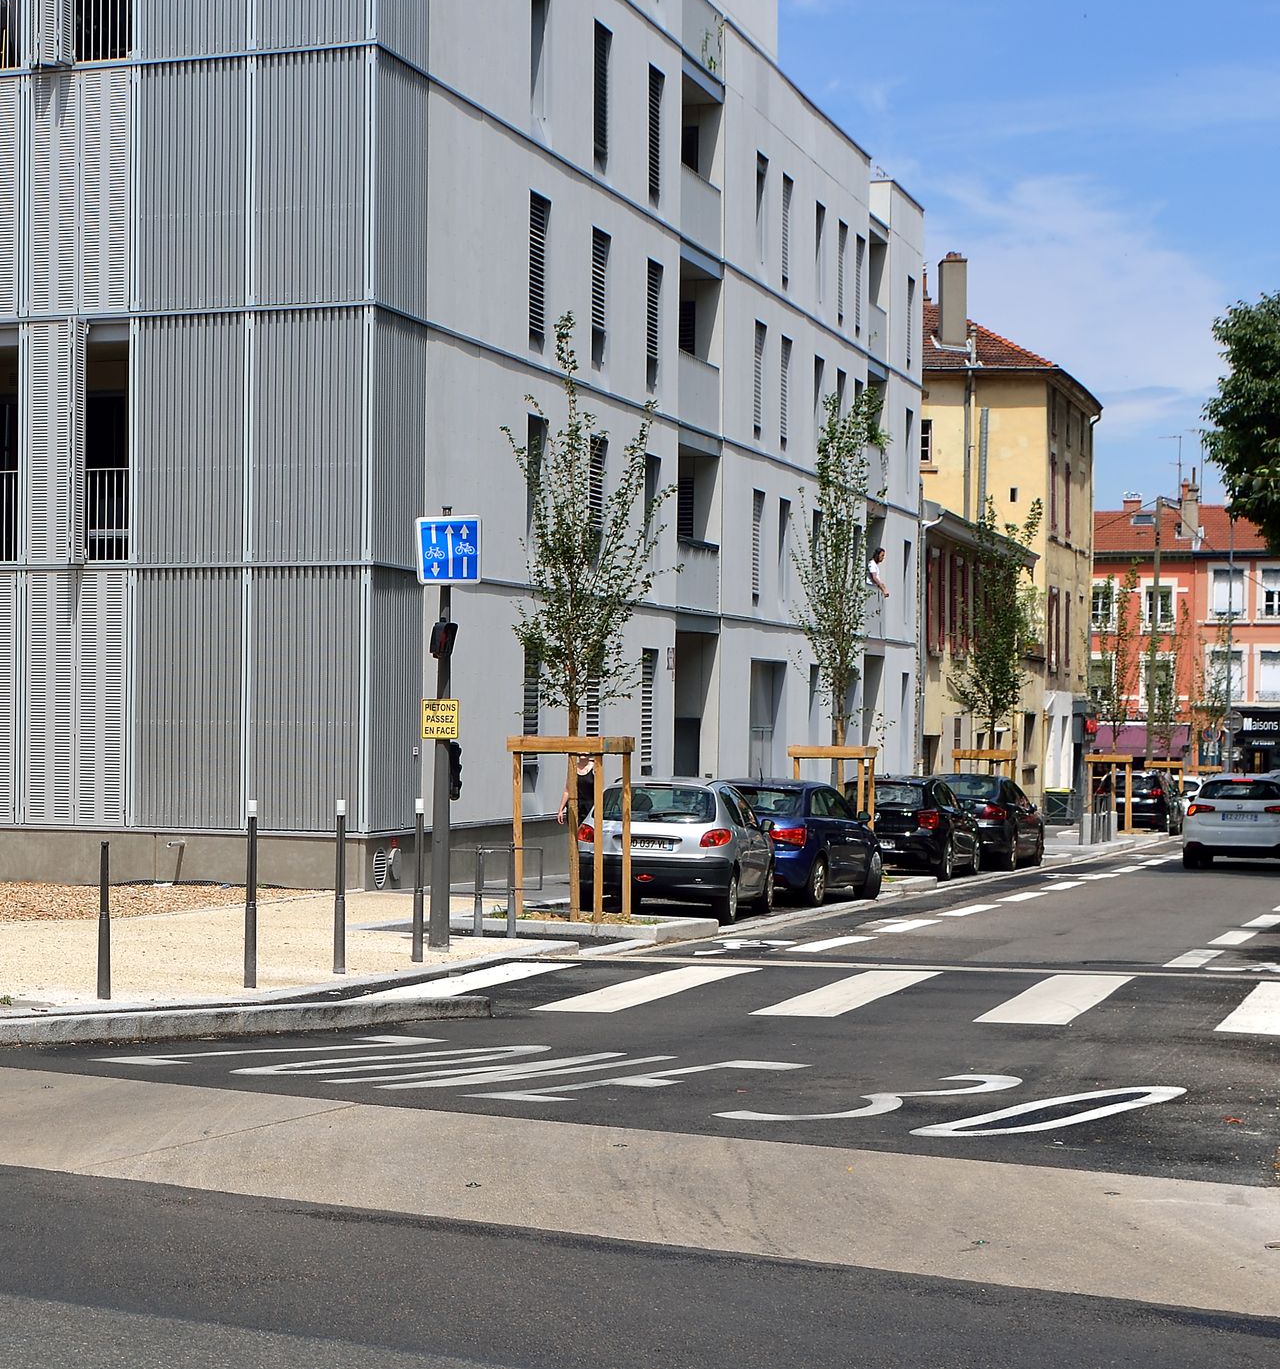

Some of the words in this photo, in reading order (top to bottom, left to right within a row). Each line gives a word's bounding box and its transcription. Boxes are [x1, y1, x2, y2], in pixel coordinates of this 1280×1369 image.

[426, 715, 454, 723] PASSEZ
[1243, 718, 1278, 730] Maisons
[711, 1073, 1188, 1138] 30
